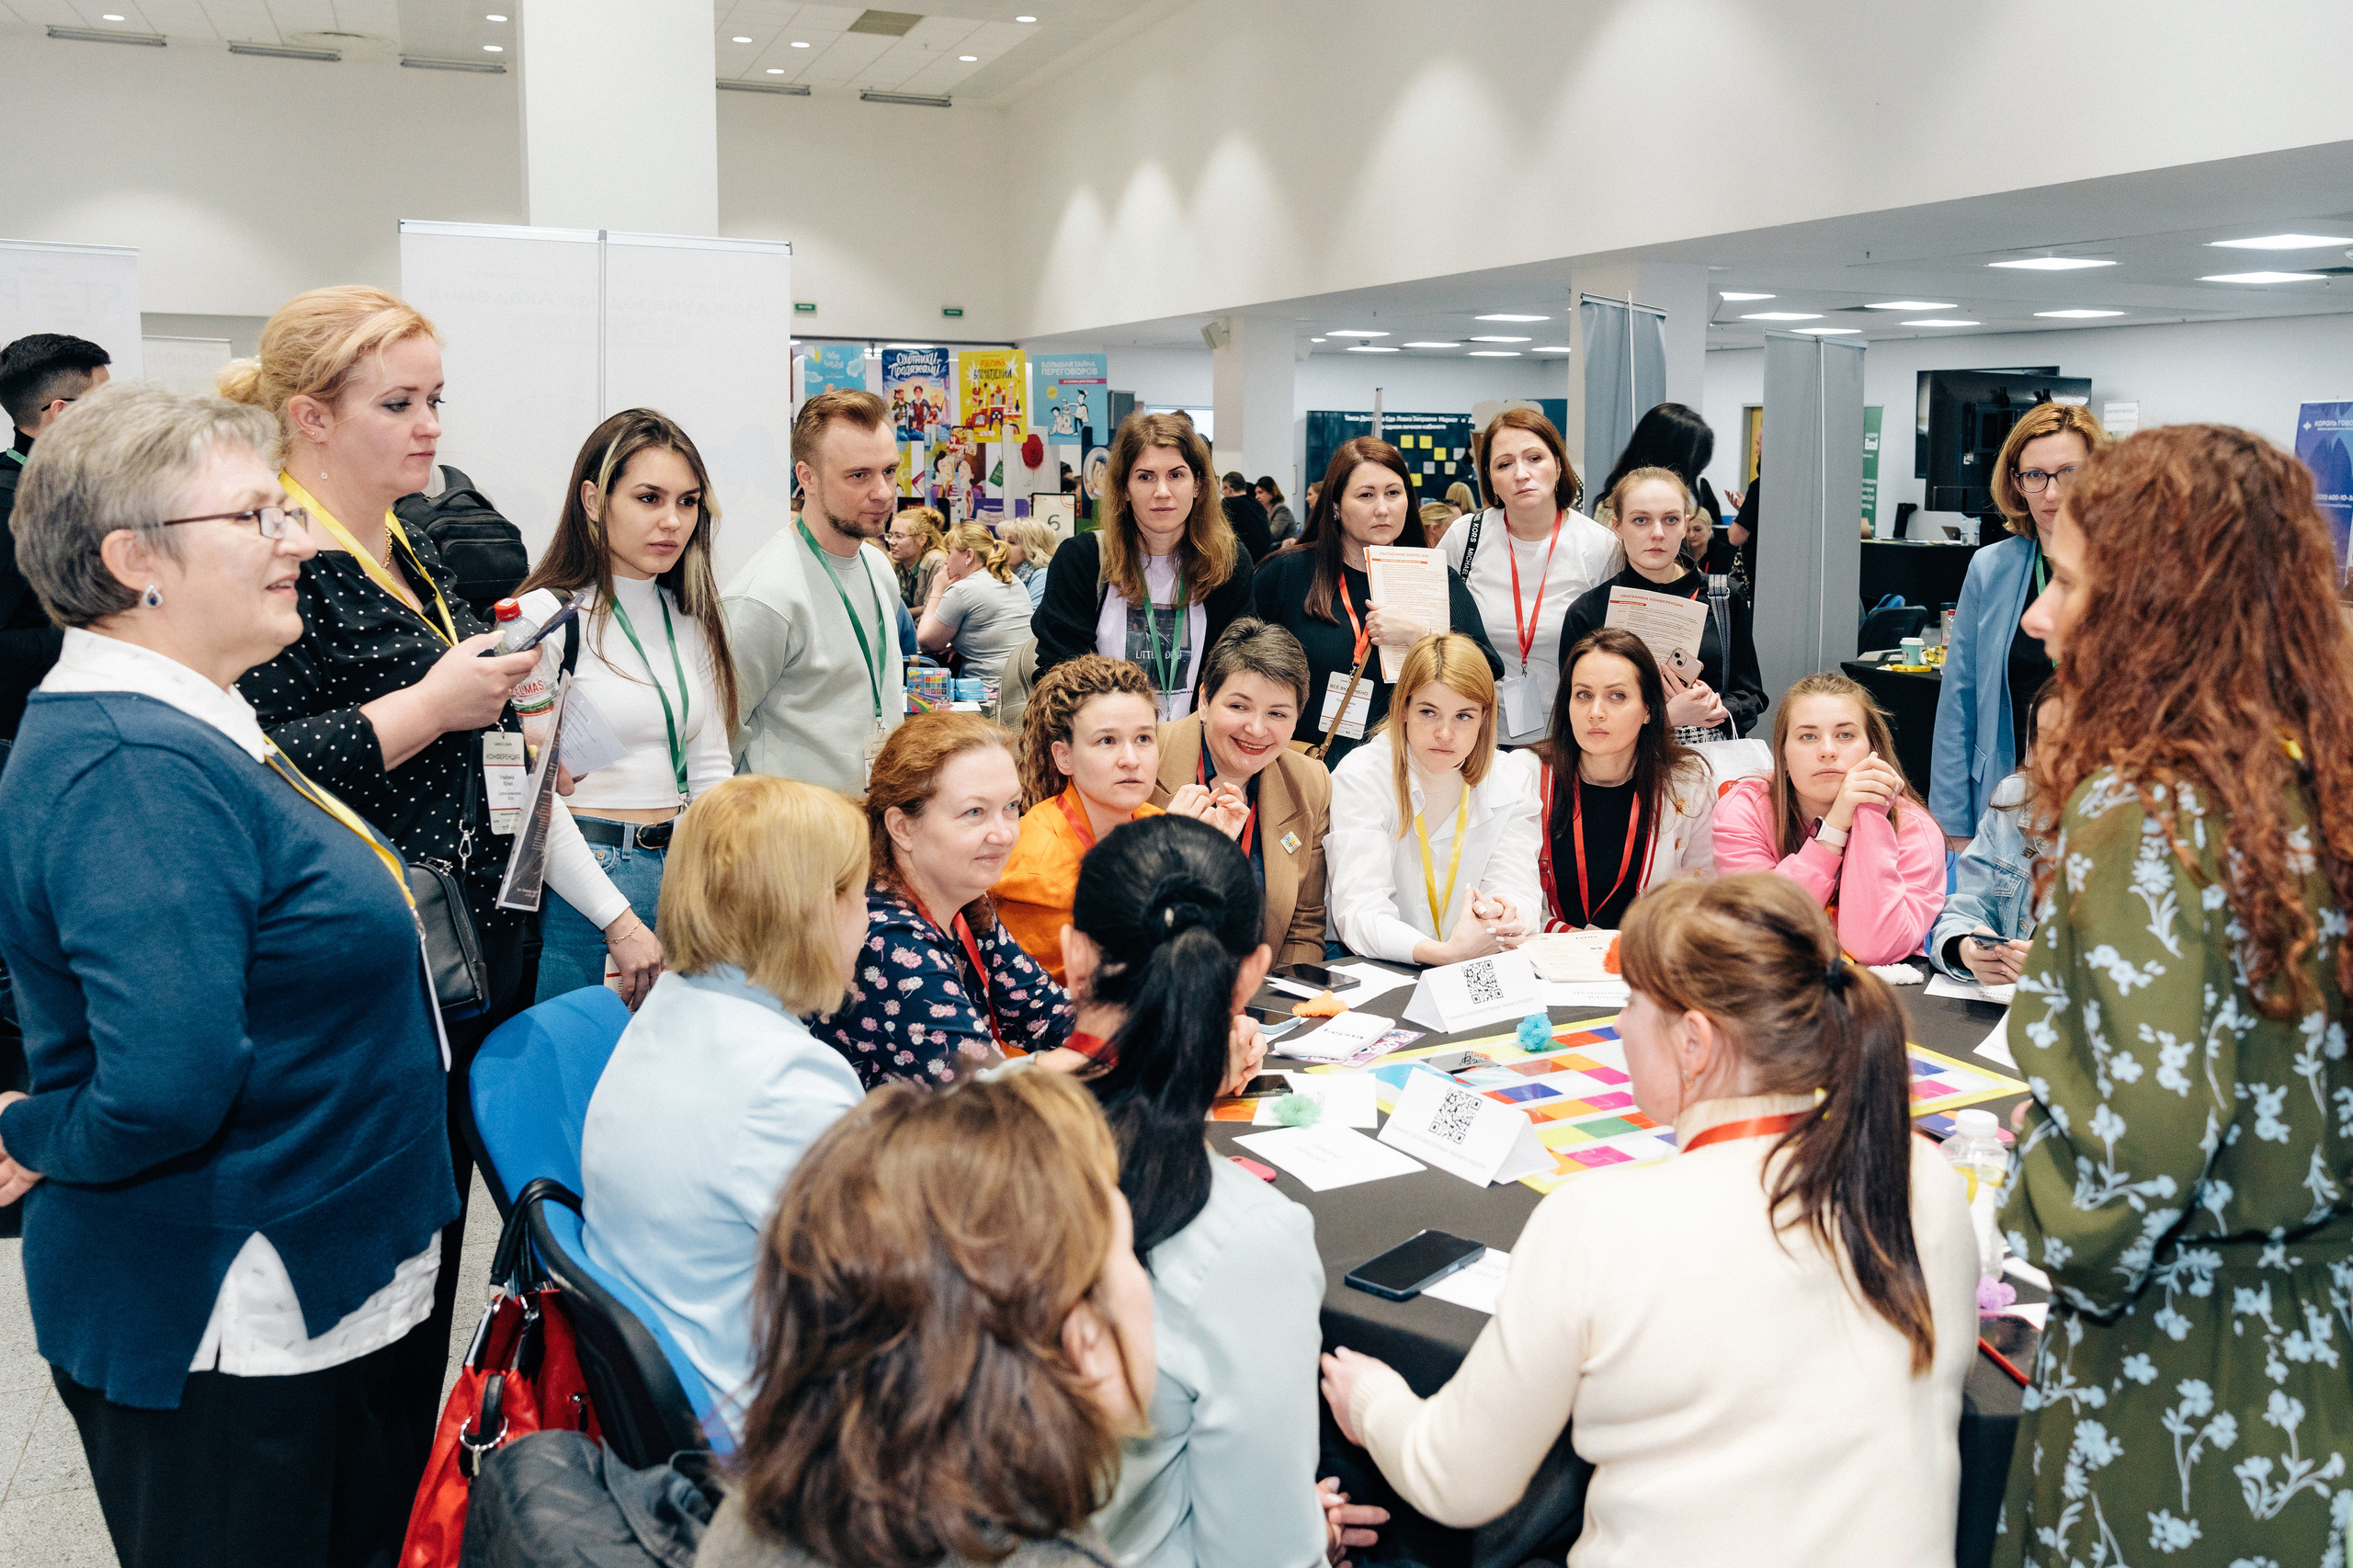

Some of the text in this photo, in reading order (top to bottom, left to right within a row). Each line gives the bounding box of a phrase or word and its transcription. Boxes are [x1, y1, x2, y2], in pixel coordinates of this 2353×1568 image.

[1471, 523, 1479, 543] KORS
[1461, 547, 1474, 575] MICHAEL
[1135, 650, 1156, 660] LITTL
